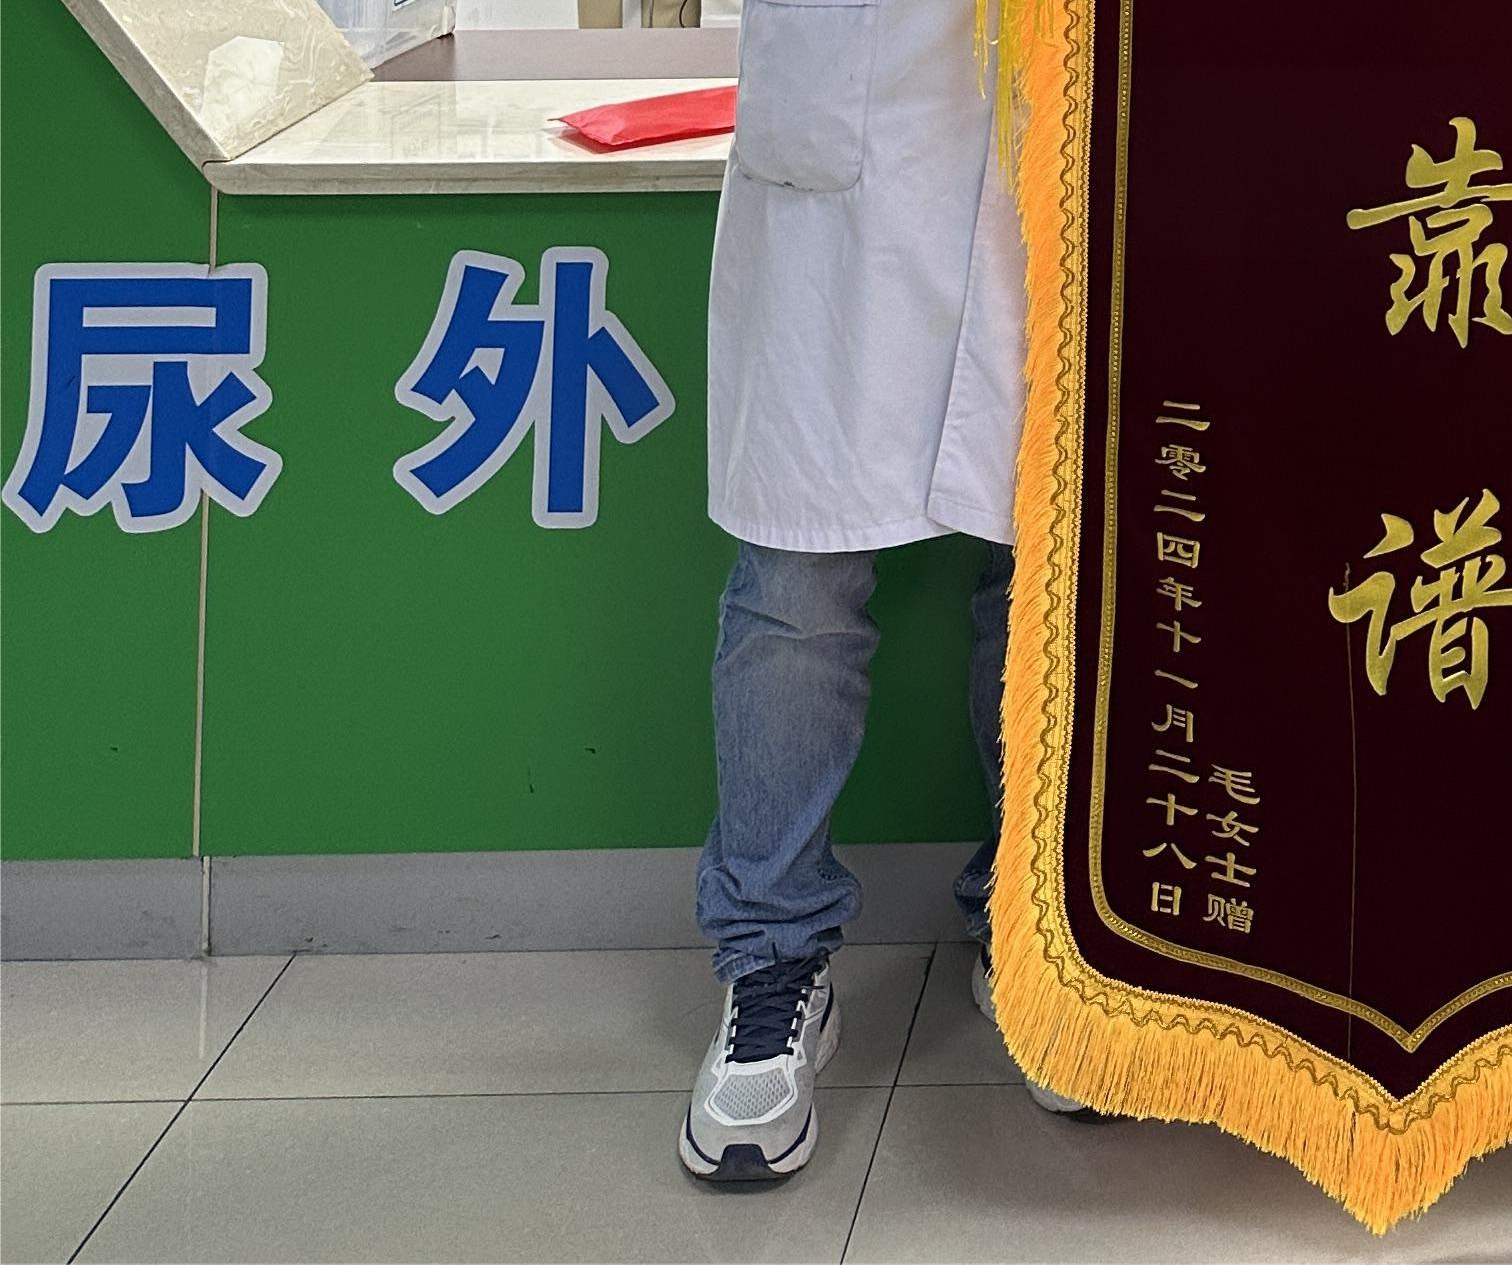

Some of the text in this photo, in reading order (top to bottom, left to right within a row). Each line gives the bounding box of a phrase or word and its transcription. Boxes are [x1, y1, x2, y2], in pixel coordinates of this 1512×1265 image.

[1142, 399, 1210, 917] 二零二四年十一月二十八日
[1202, 763, 1261, 934] 毛女士赠
